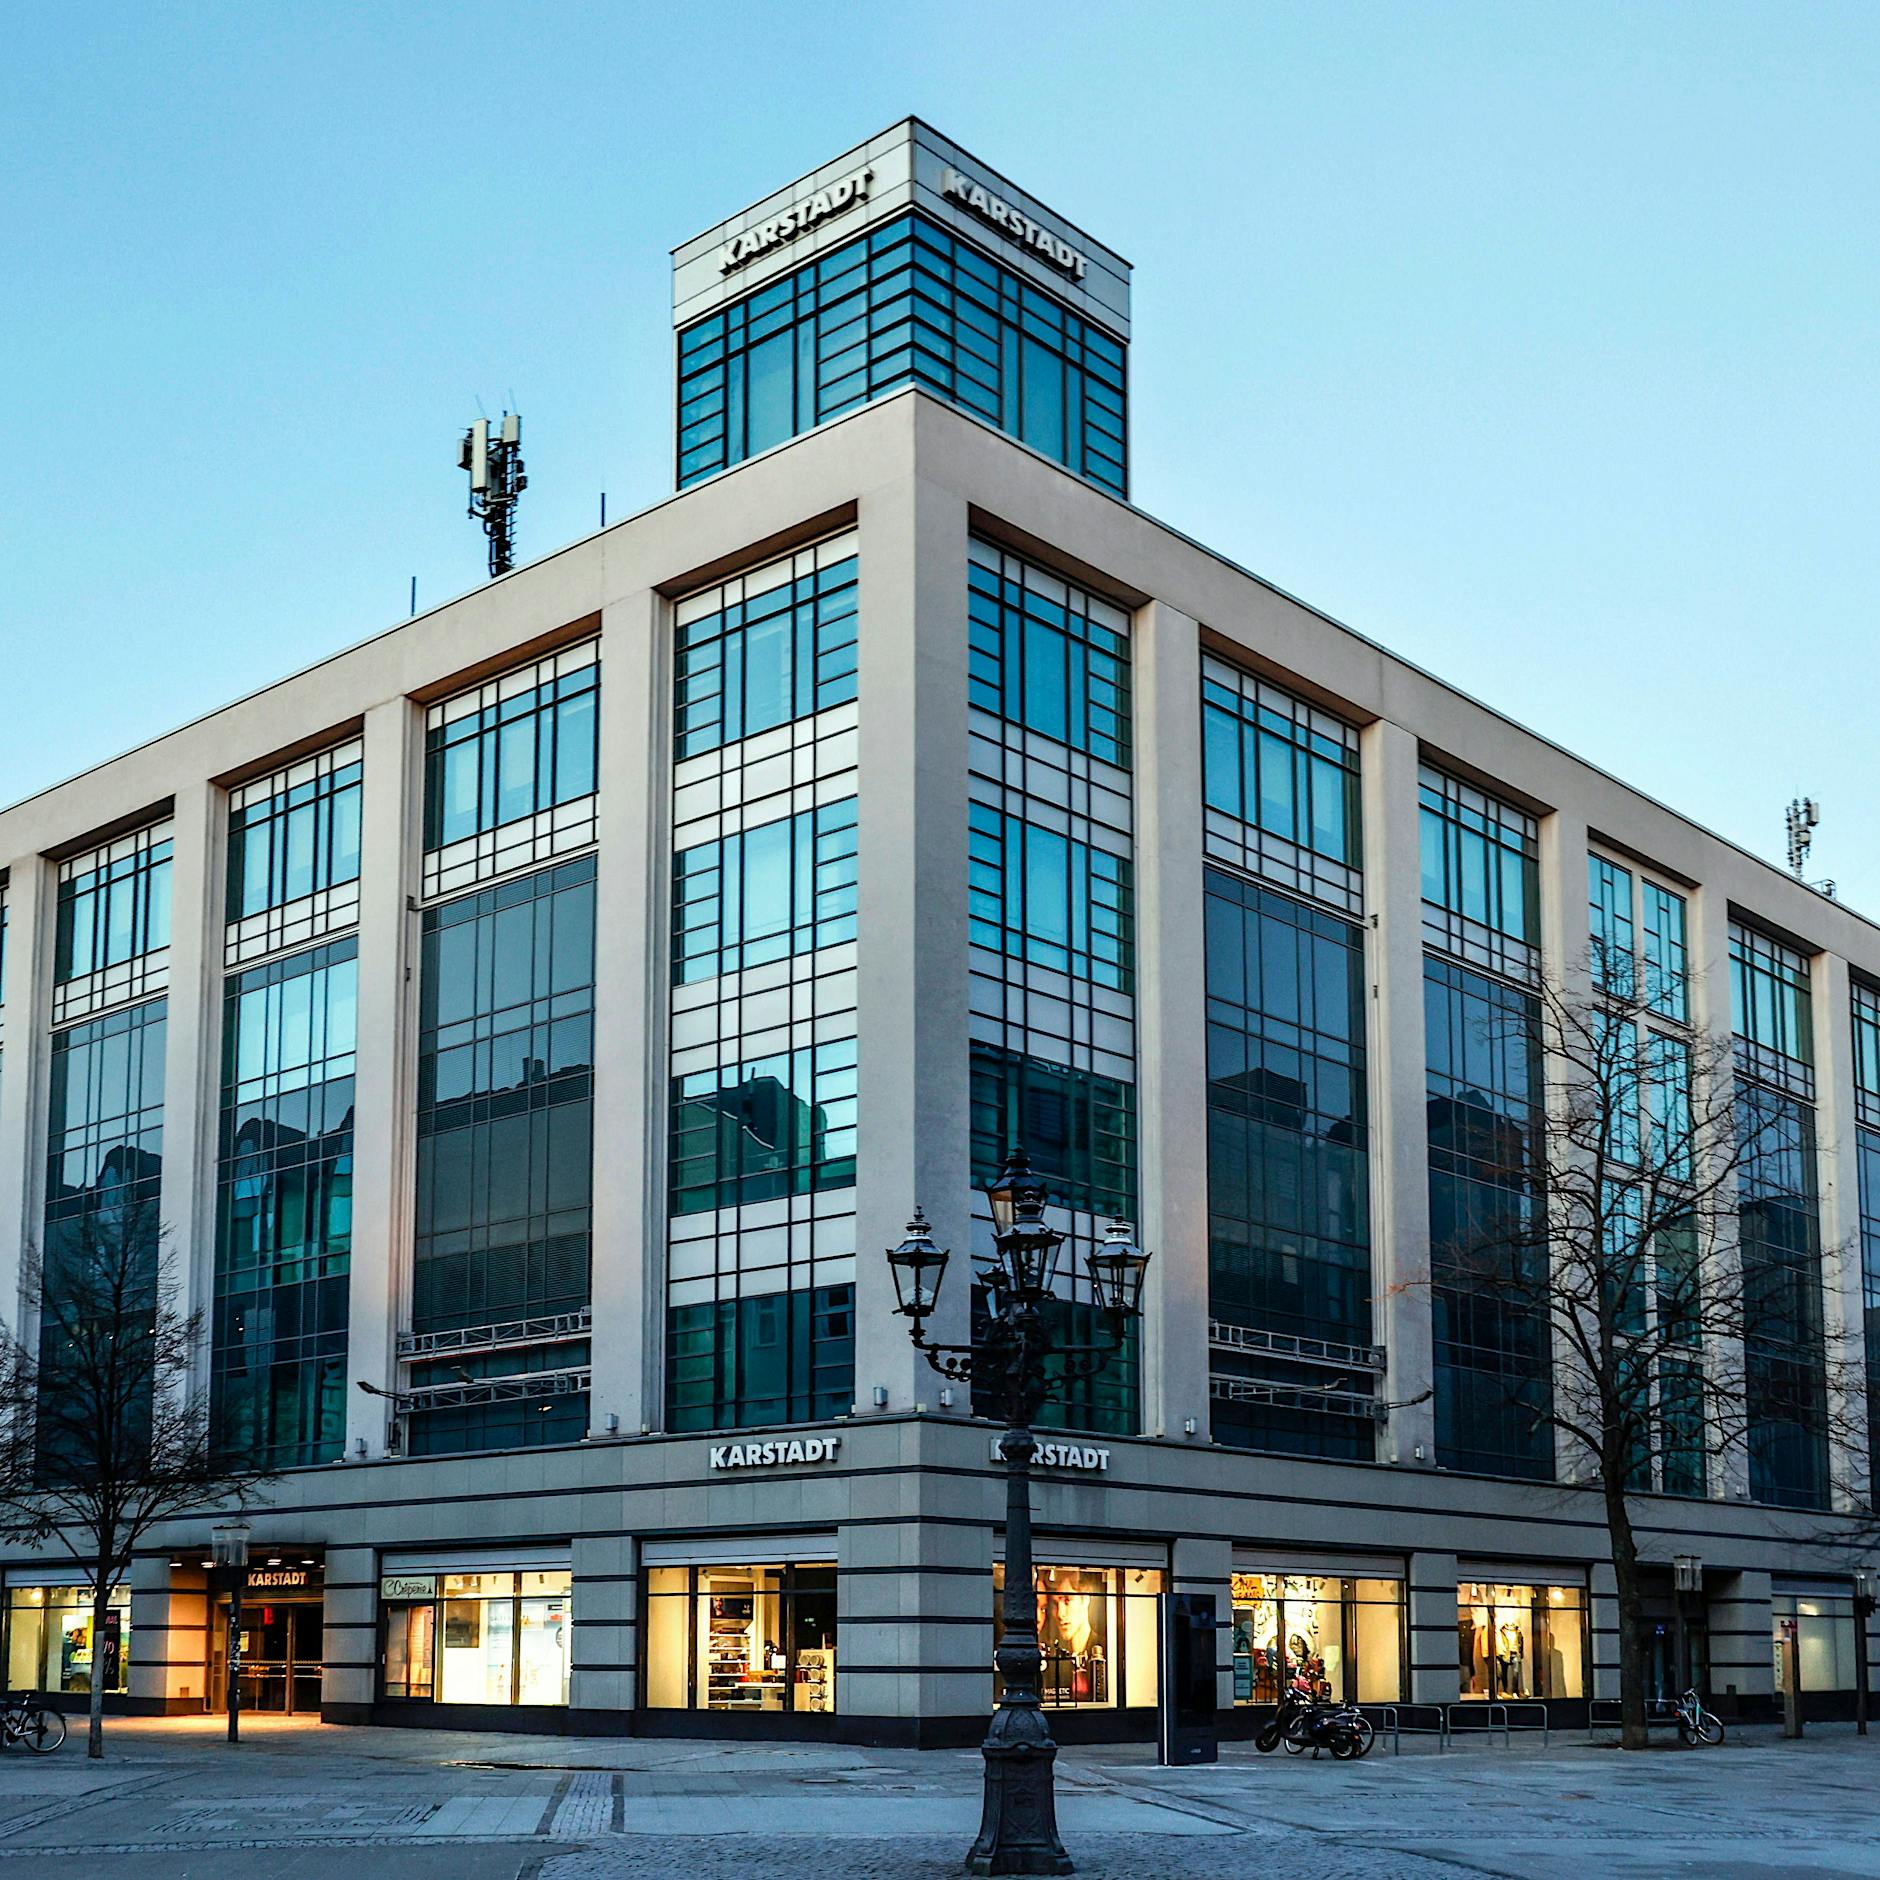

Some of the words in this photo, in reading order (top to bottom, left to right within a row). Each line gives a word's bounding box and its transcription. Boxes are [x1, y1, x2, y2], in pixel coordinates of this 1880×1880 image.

[719, 167, 873, 273] KARSTADT
[943, 167, 1087, 280] KARSTADT
[710, 1438, 839, 1468] KARSTADT
[991, 1439, 1110, 1470] KRSTADT
[248, 1571, 307, 1586] KARSTADT
[1044, 1687, 1070, 1695] MAGETIC
